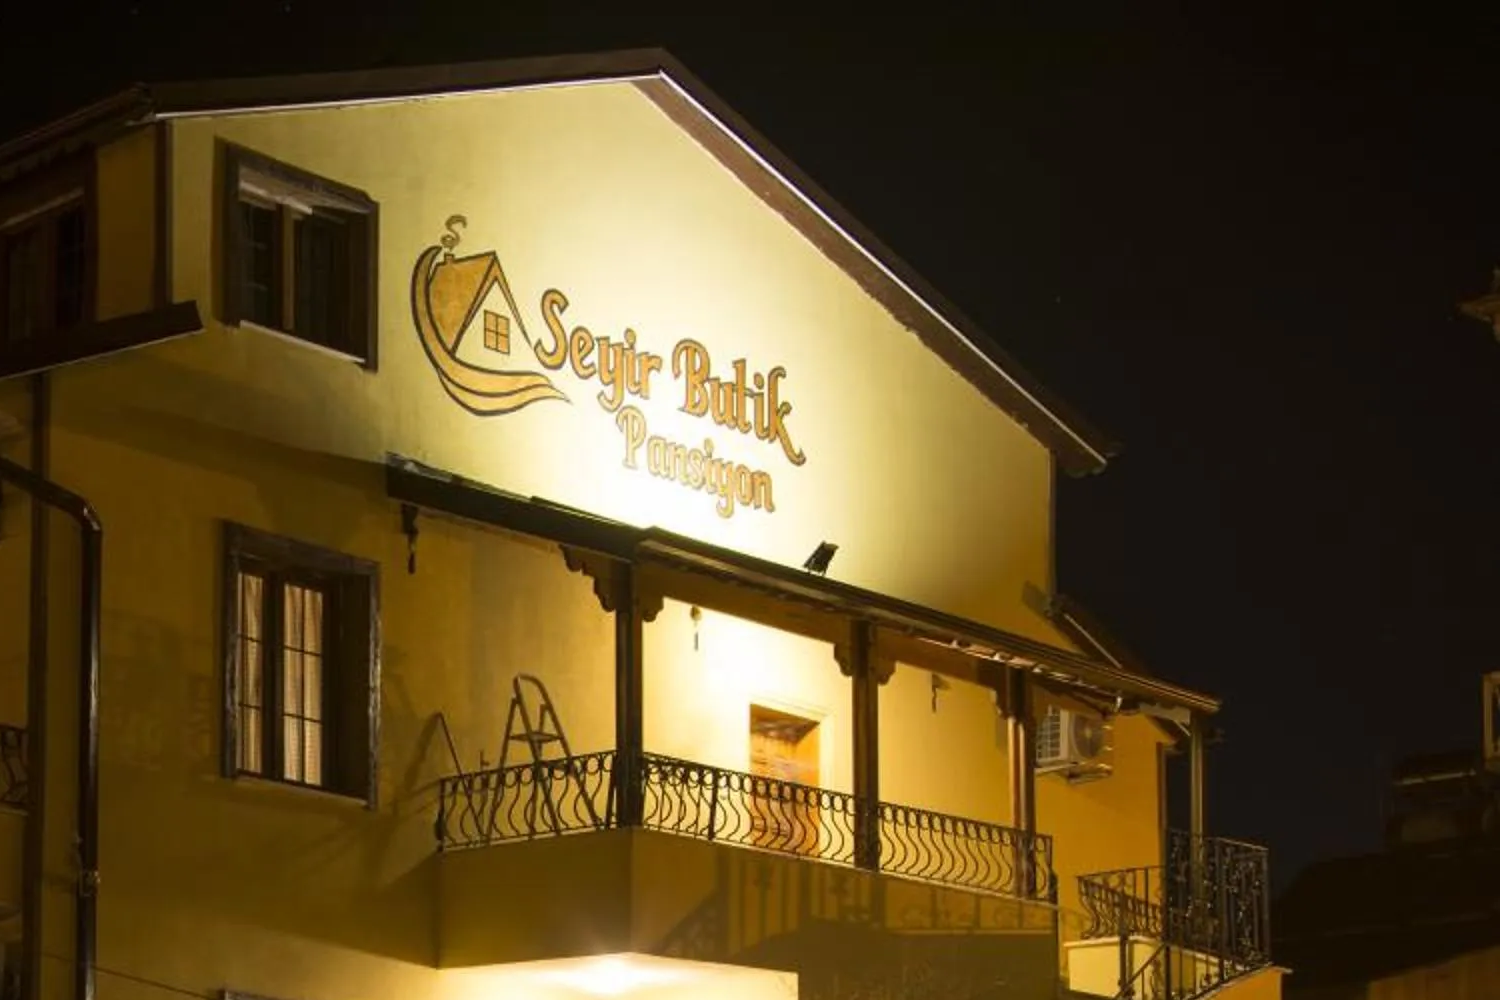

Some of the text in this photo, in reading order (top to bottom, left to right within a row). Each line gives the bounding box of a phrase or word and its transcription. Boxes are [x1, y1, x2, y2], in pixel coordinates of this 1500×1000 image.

[534, 289, 806, 466] Seyir Butik
[616, 405, 775, 518] Pansiyon
